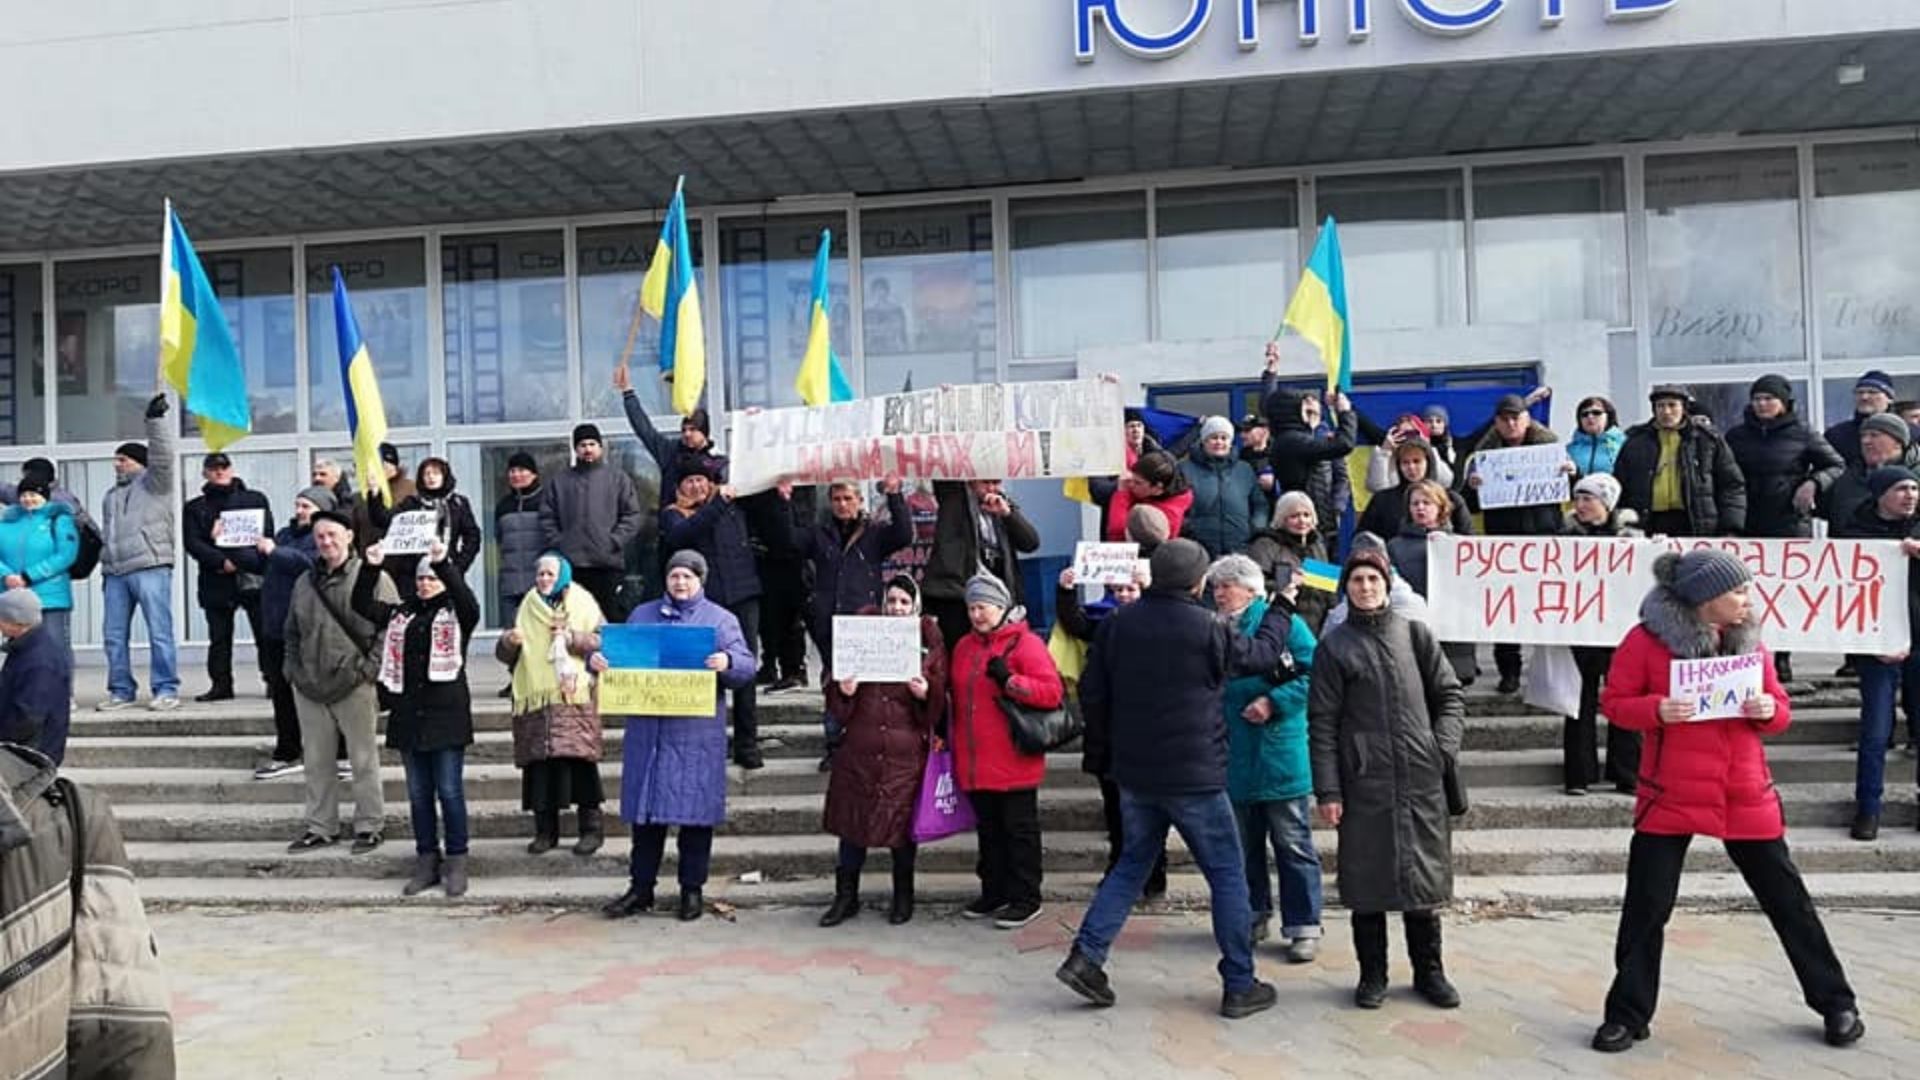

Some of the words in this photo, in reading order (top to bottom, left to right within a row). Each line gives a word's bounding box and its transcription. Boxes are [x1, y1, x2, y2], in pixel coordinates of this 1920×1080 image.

[1074, 0, 1678, 62] ЮНІС
[1455, 541, 1635, 578] РУССКИЙ
[1666, 538, 1885, 584] АБЛЬ,
[1754, 580, 1881, 634] ХУЙ!
